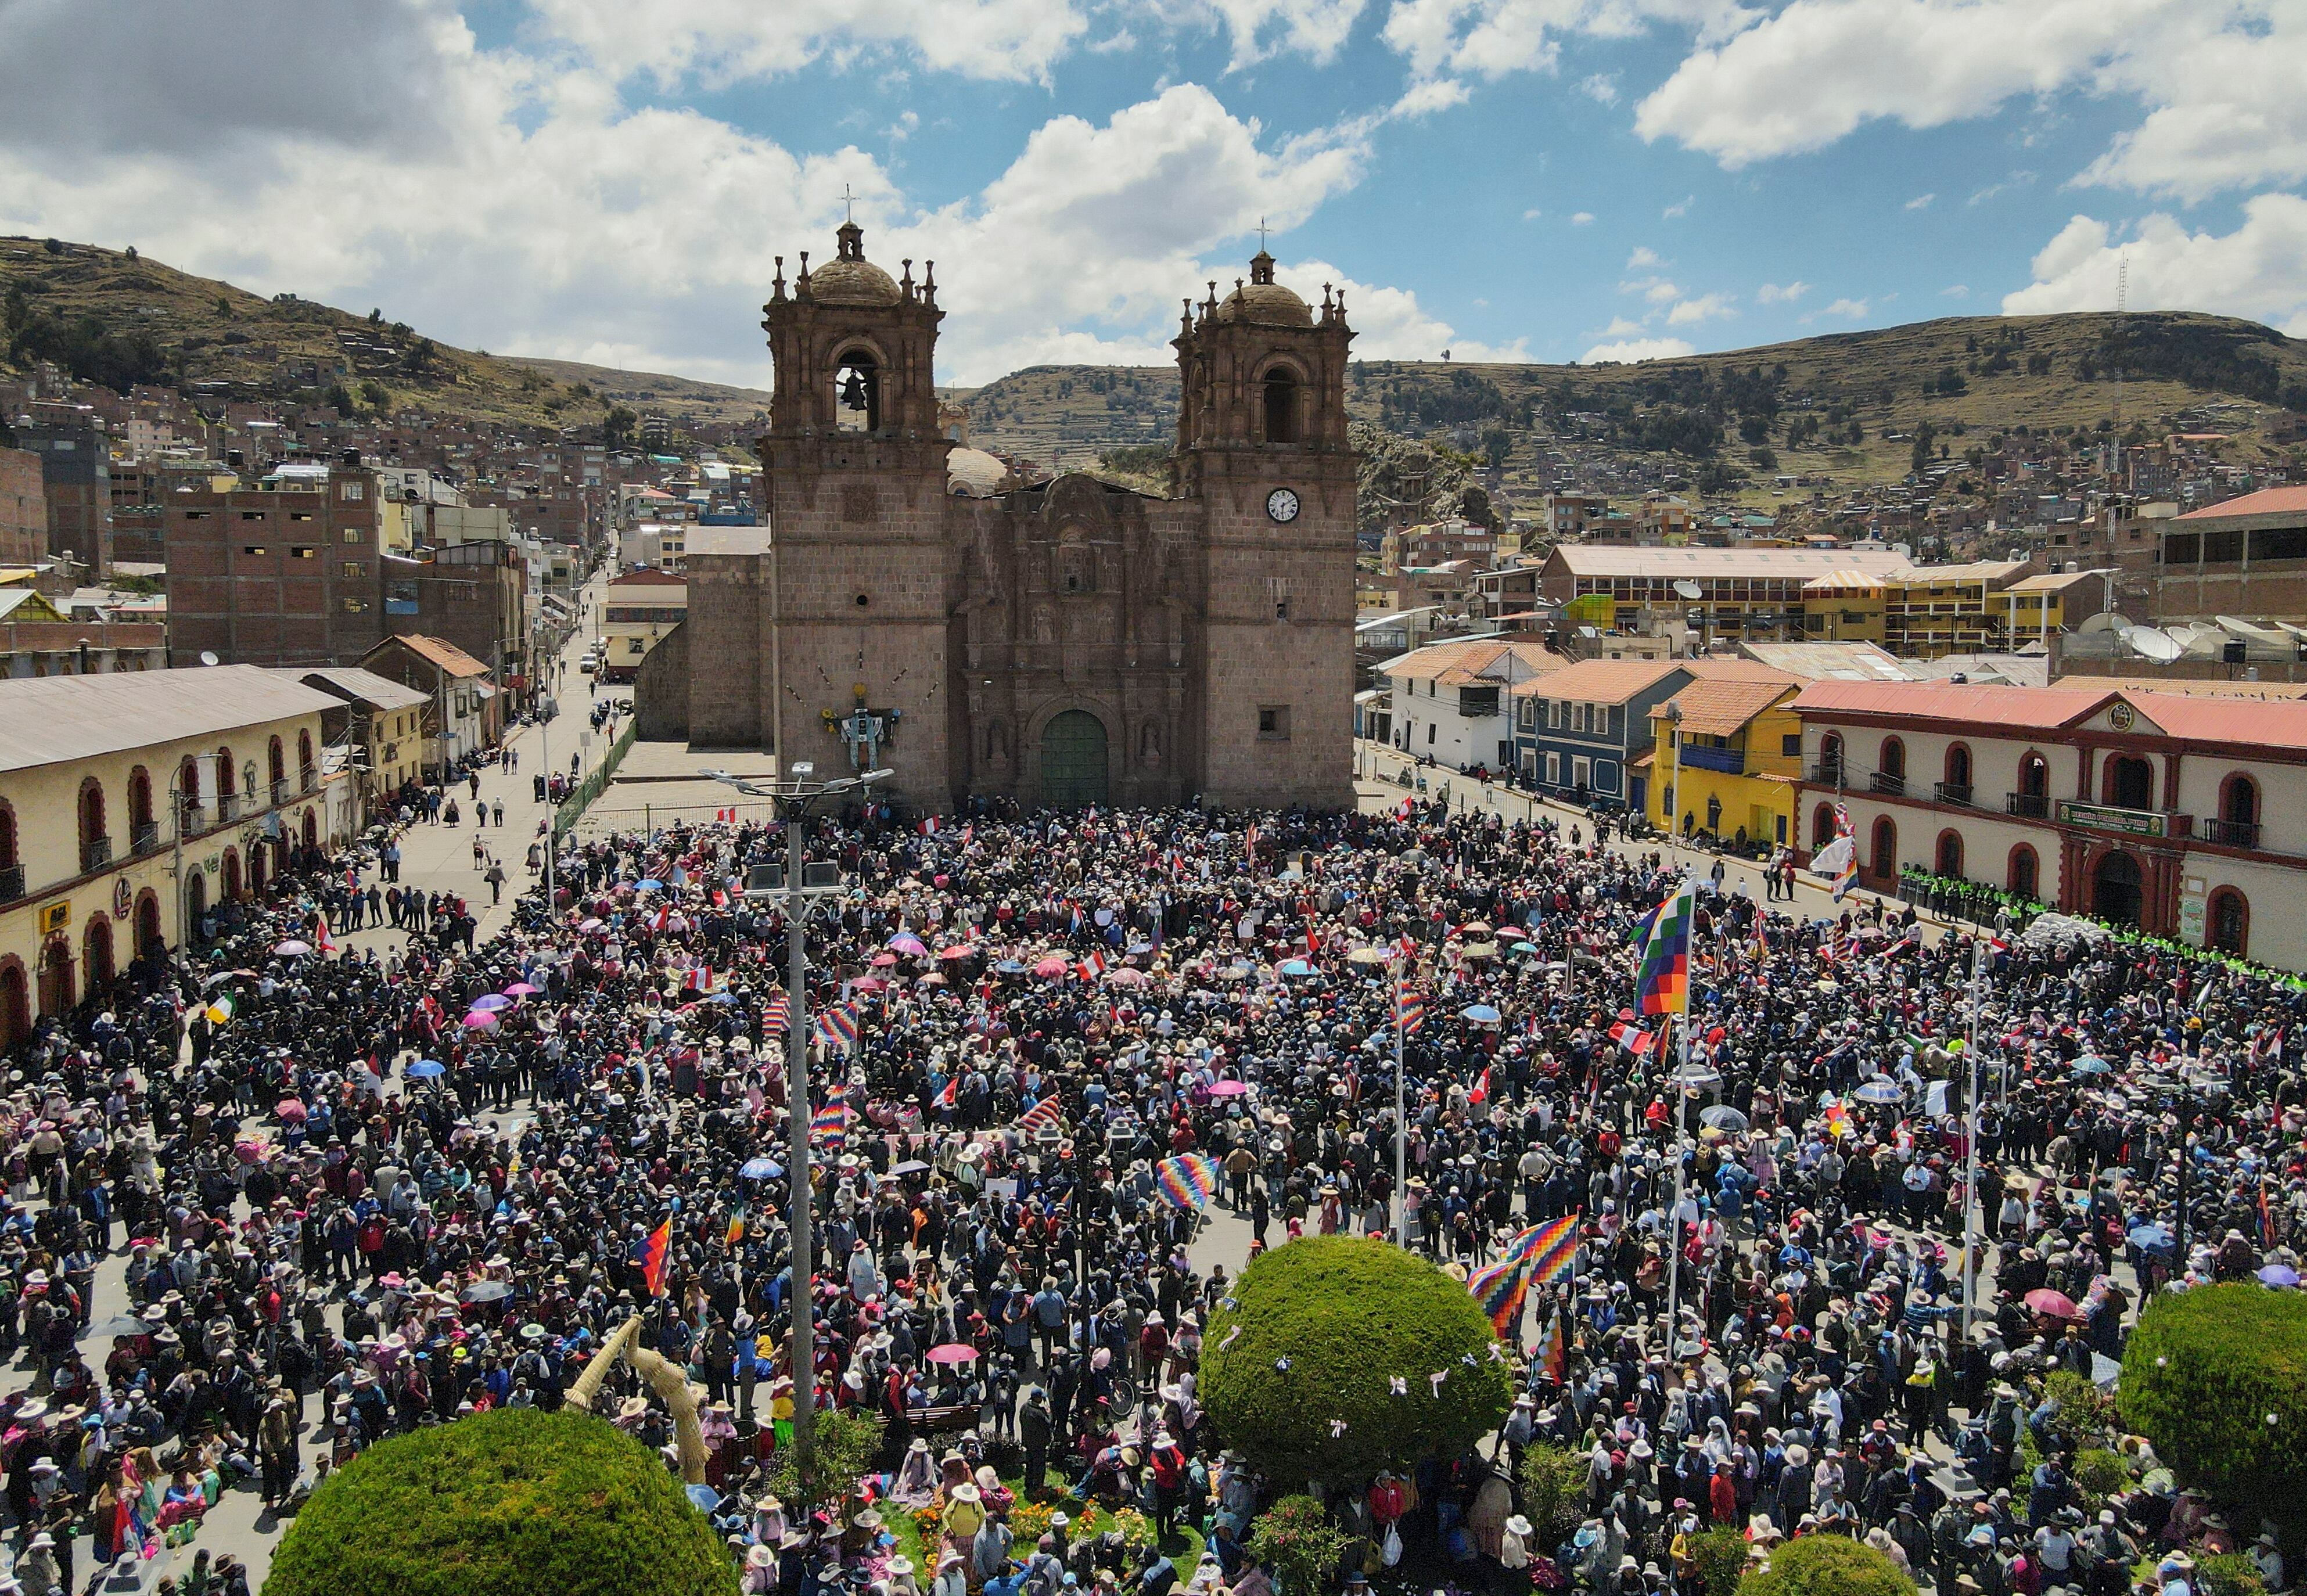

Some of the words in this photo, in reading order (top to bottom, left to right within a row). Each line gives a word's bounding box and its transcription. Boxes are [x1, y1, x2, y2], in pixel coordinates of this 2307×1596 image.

[2071, 811, 2096, 820] REGIÓN
[2097, 814, 2127, 824] POLICIAL
[2128, 818, 2148, 827] PUNO
